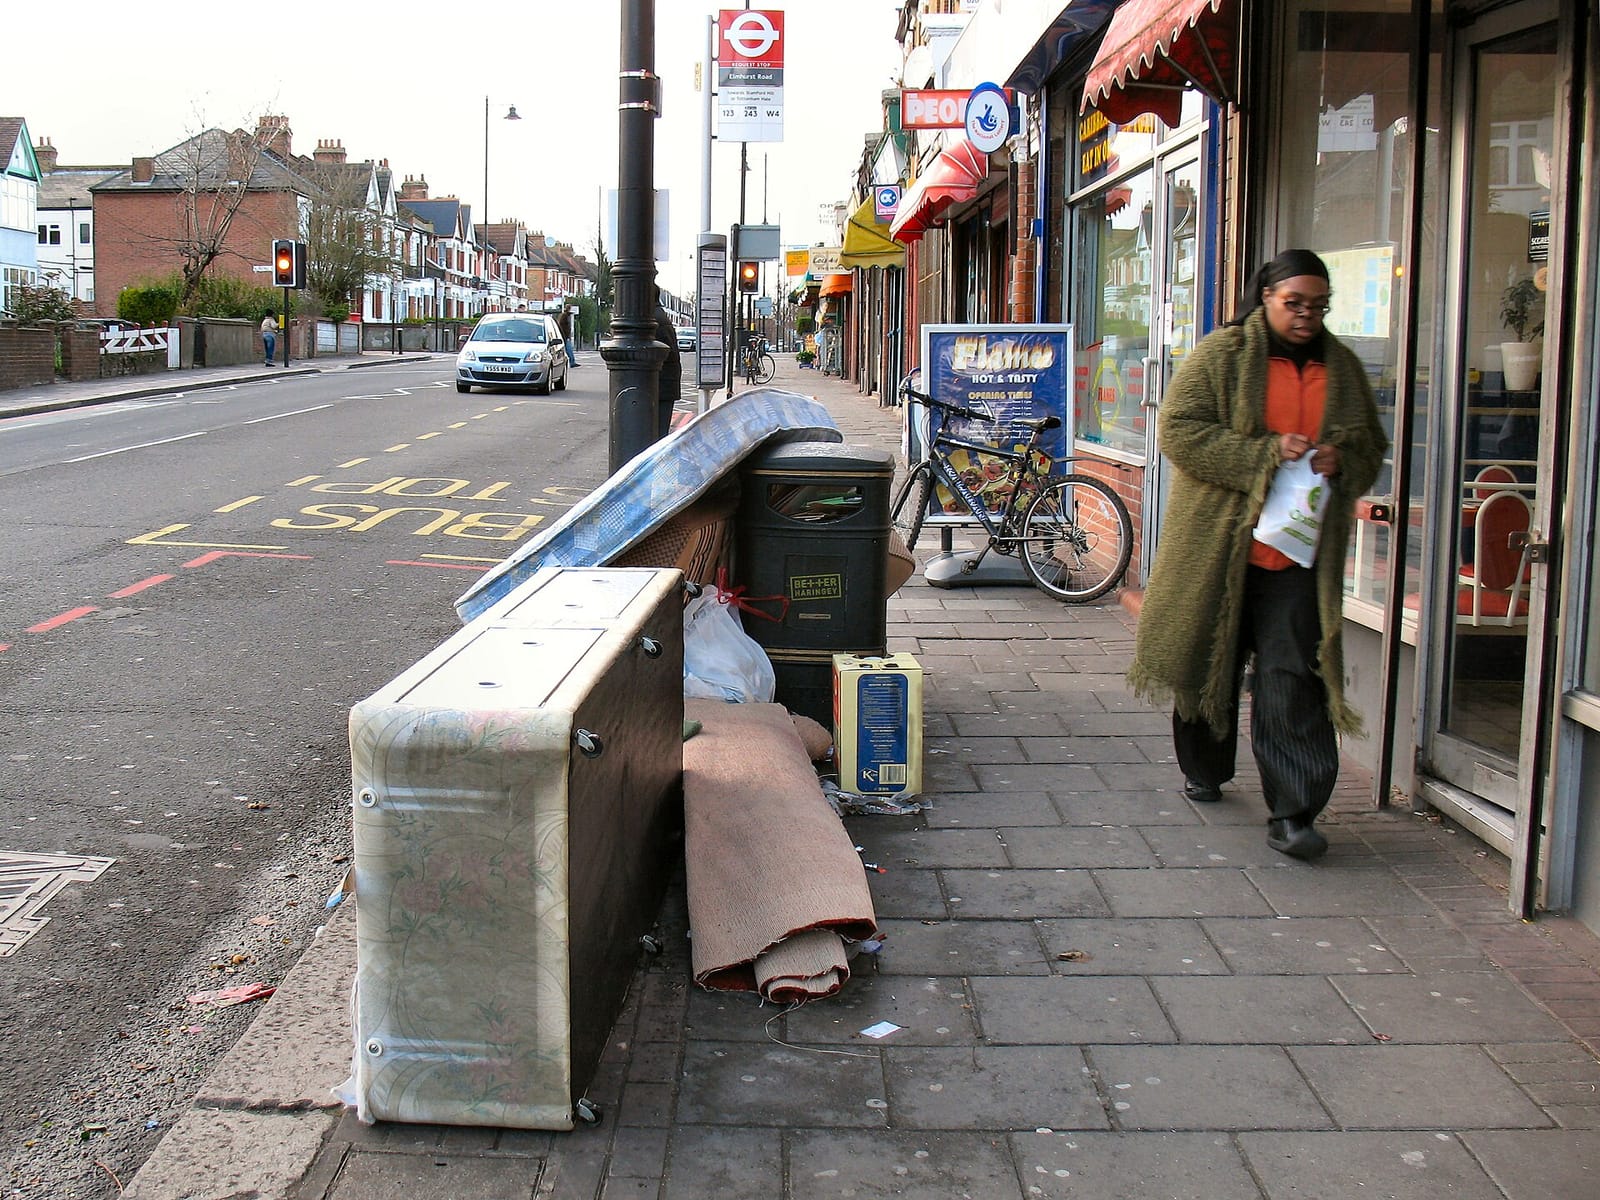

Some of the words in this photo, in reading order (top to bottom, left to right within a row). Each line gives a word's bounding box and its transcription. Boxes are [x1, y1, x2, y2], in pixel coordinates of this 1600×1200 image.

[972, 374, 994, 384] HOT
[997, 374, 1005, 384] &
[1007, 373, 1039, 384] TASTY
[968, 391, 1006, 400] OPENING
[1007, 391, 1033, 399] TIMES
[270, 503, 544, 541] BUS
[794, 587, 839, 597] HARINGEY
